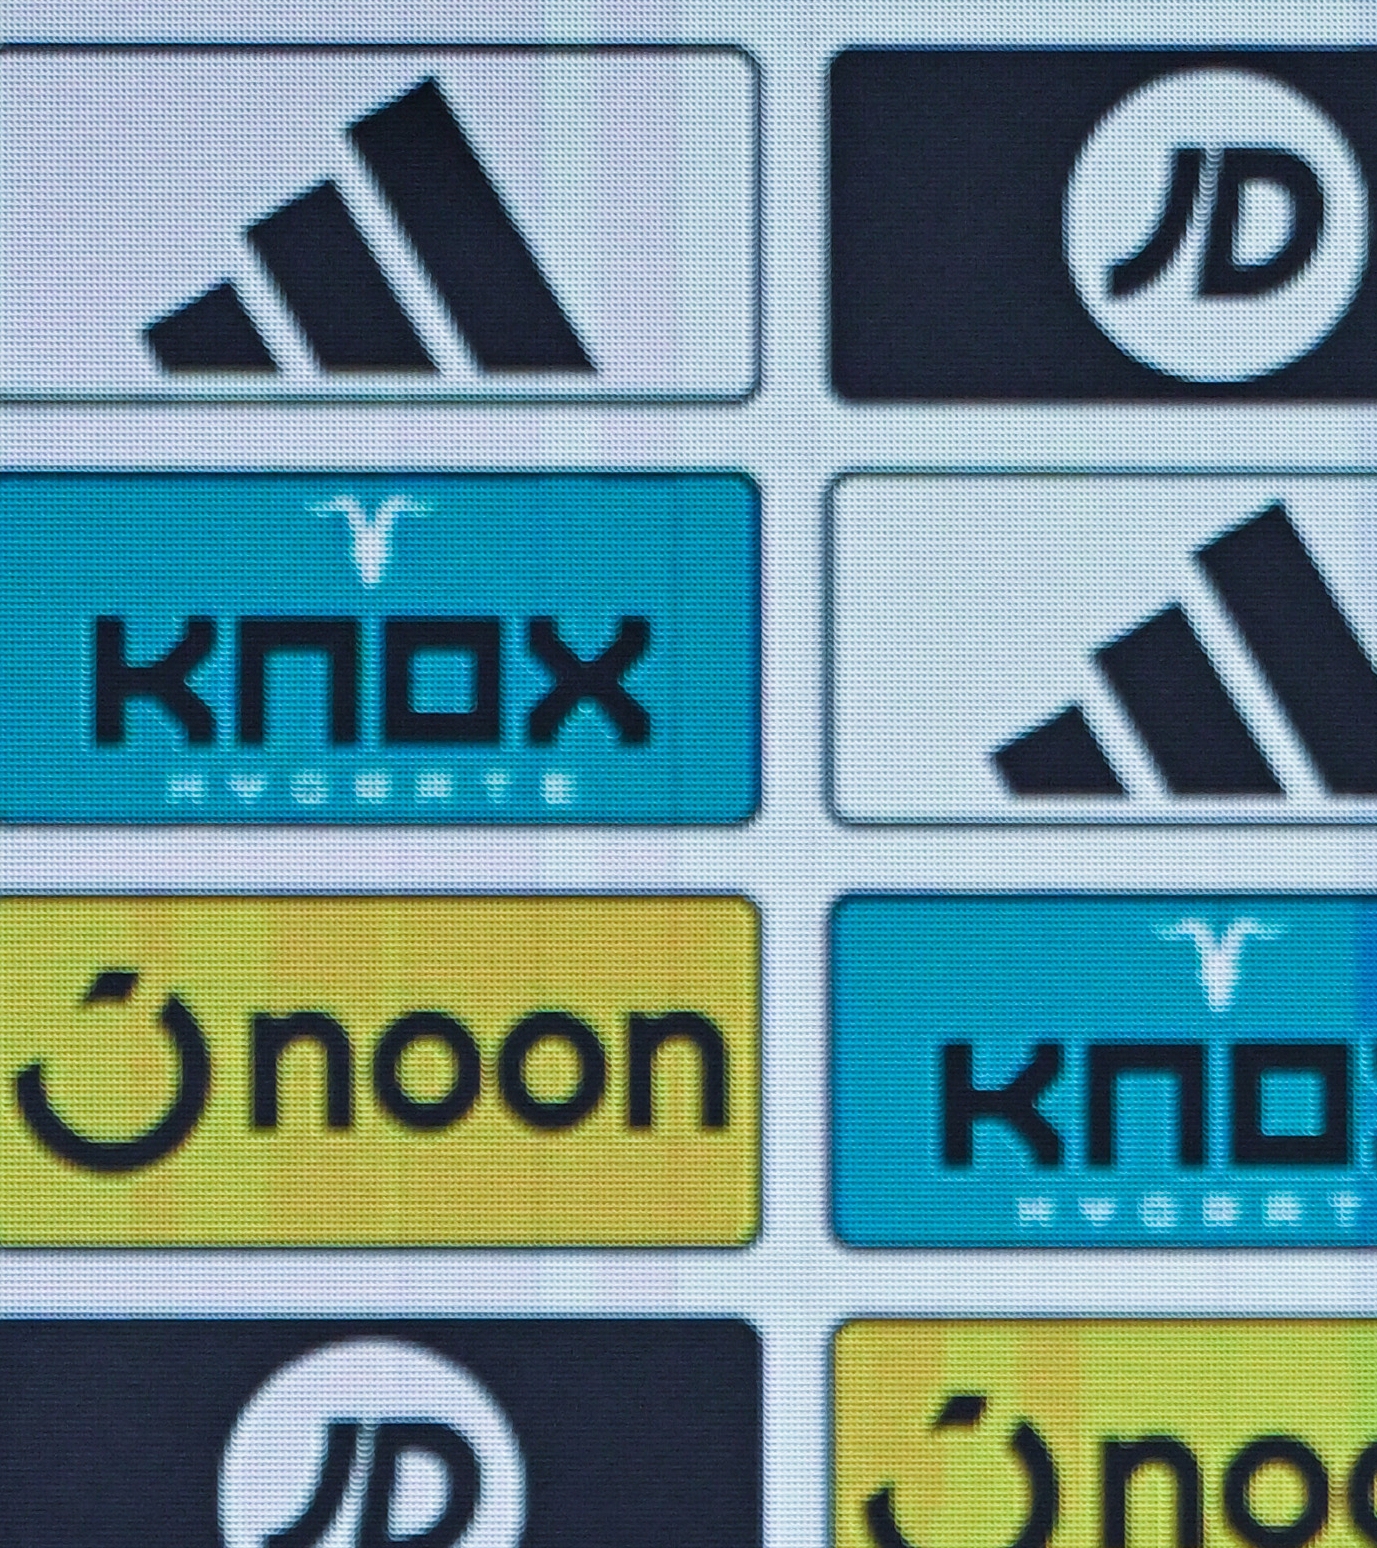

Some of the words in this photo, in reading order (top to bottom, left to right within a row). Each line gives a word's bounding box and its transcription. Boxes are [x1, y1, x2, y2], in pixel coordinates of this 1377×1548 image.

[1106, 145, 1327, 300] JD
[92, 614, 653, 749] KNOX
[250, 1009, 730, 1130] noon
